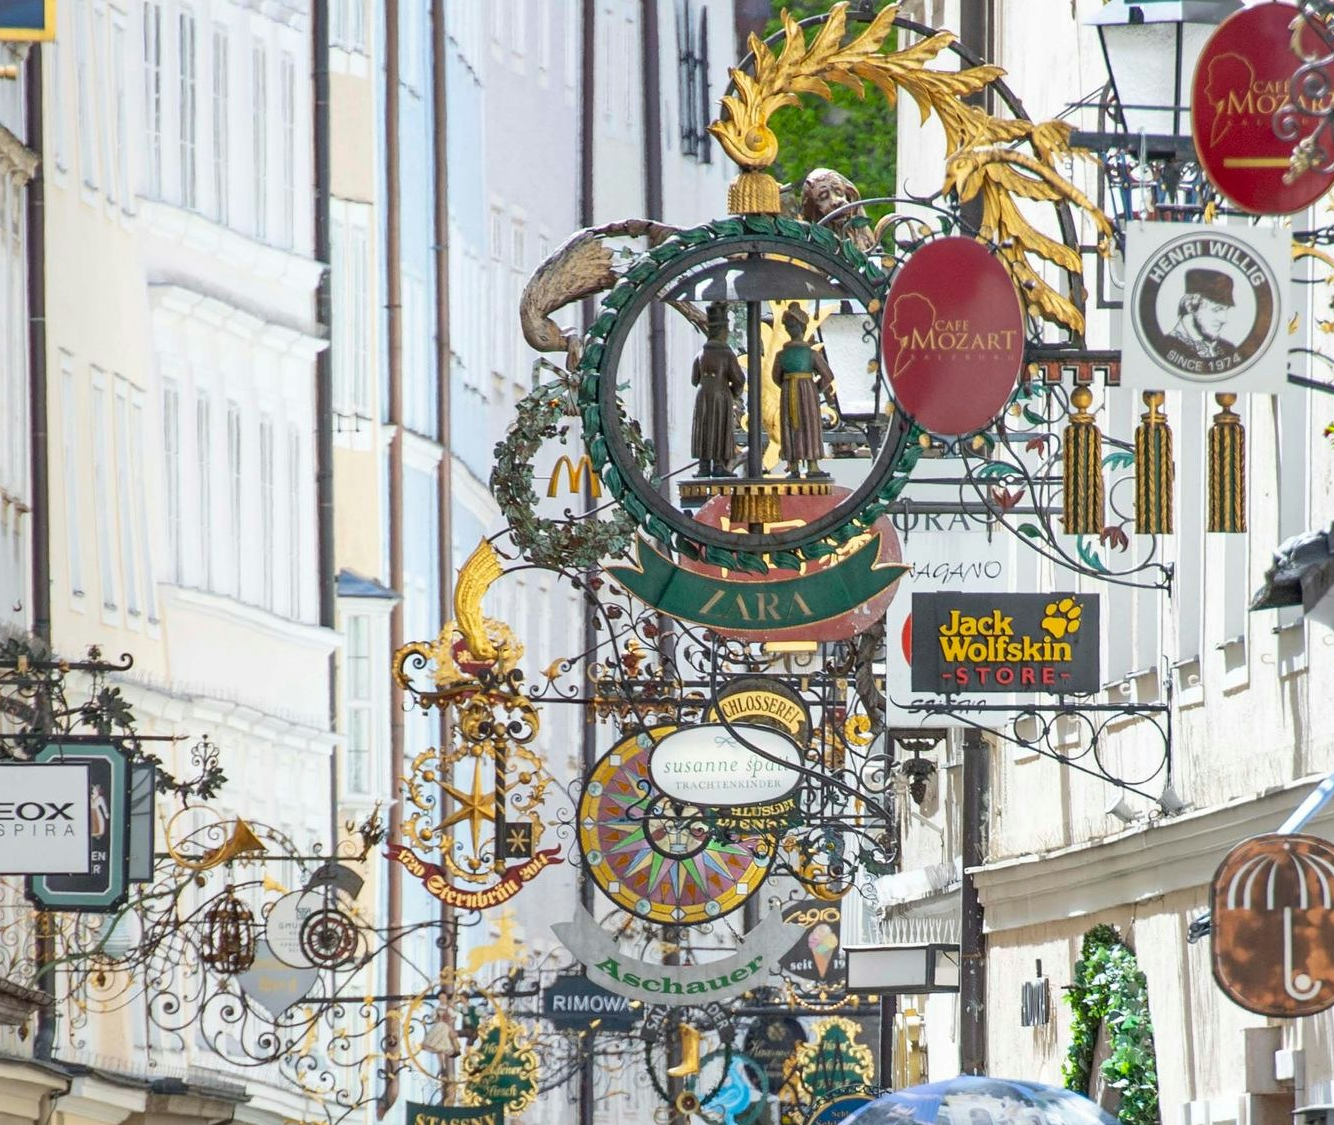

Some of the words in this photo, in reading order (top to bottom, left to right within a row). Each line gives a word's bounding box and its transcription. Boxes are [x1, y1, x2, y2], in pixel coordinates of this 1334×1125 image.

[1149, 241, 1202, 284] HENRI
[1209, 240, 1265, 287] WILLIG
[1166, 350, 1203, 372] SINCE
[1208, 352, 1241, 372] 1974
[698, 587, 813, 622] ZARA
[939, 609, 1014, 636] Jack
[938, 636, 1073, 663] Wolfskin
[663, 759, 738, 774] susanne
[675, 779, 782, 791] TRACHTENKINDER
[427, 875, 519, 909] Sternbräu
[594, 955, 764, 995] Aschauer
[790, 958, 812, 970] seit
[553, 995, 632, 1013] RIMOWA
